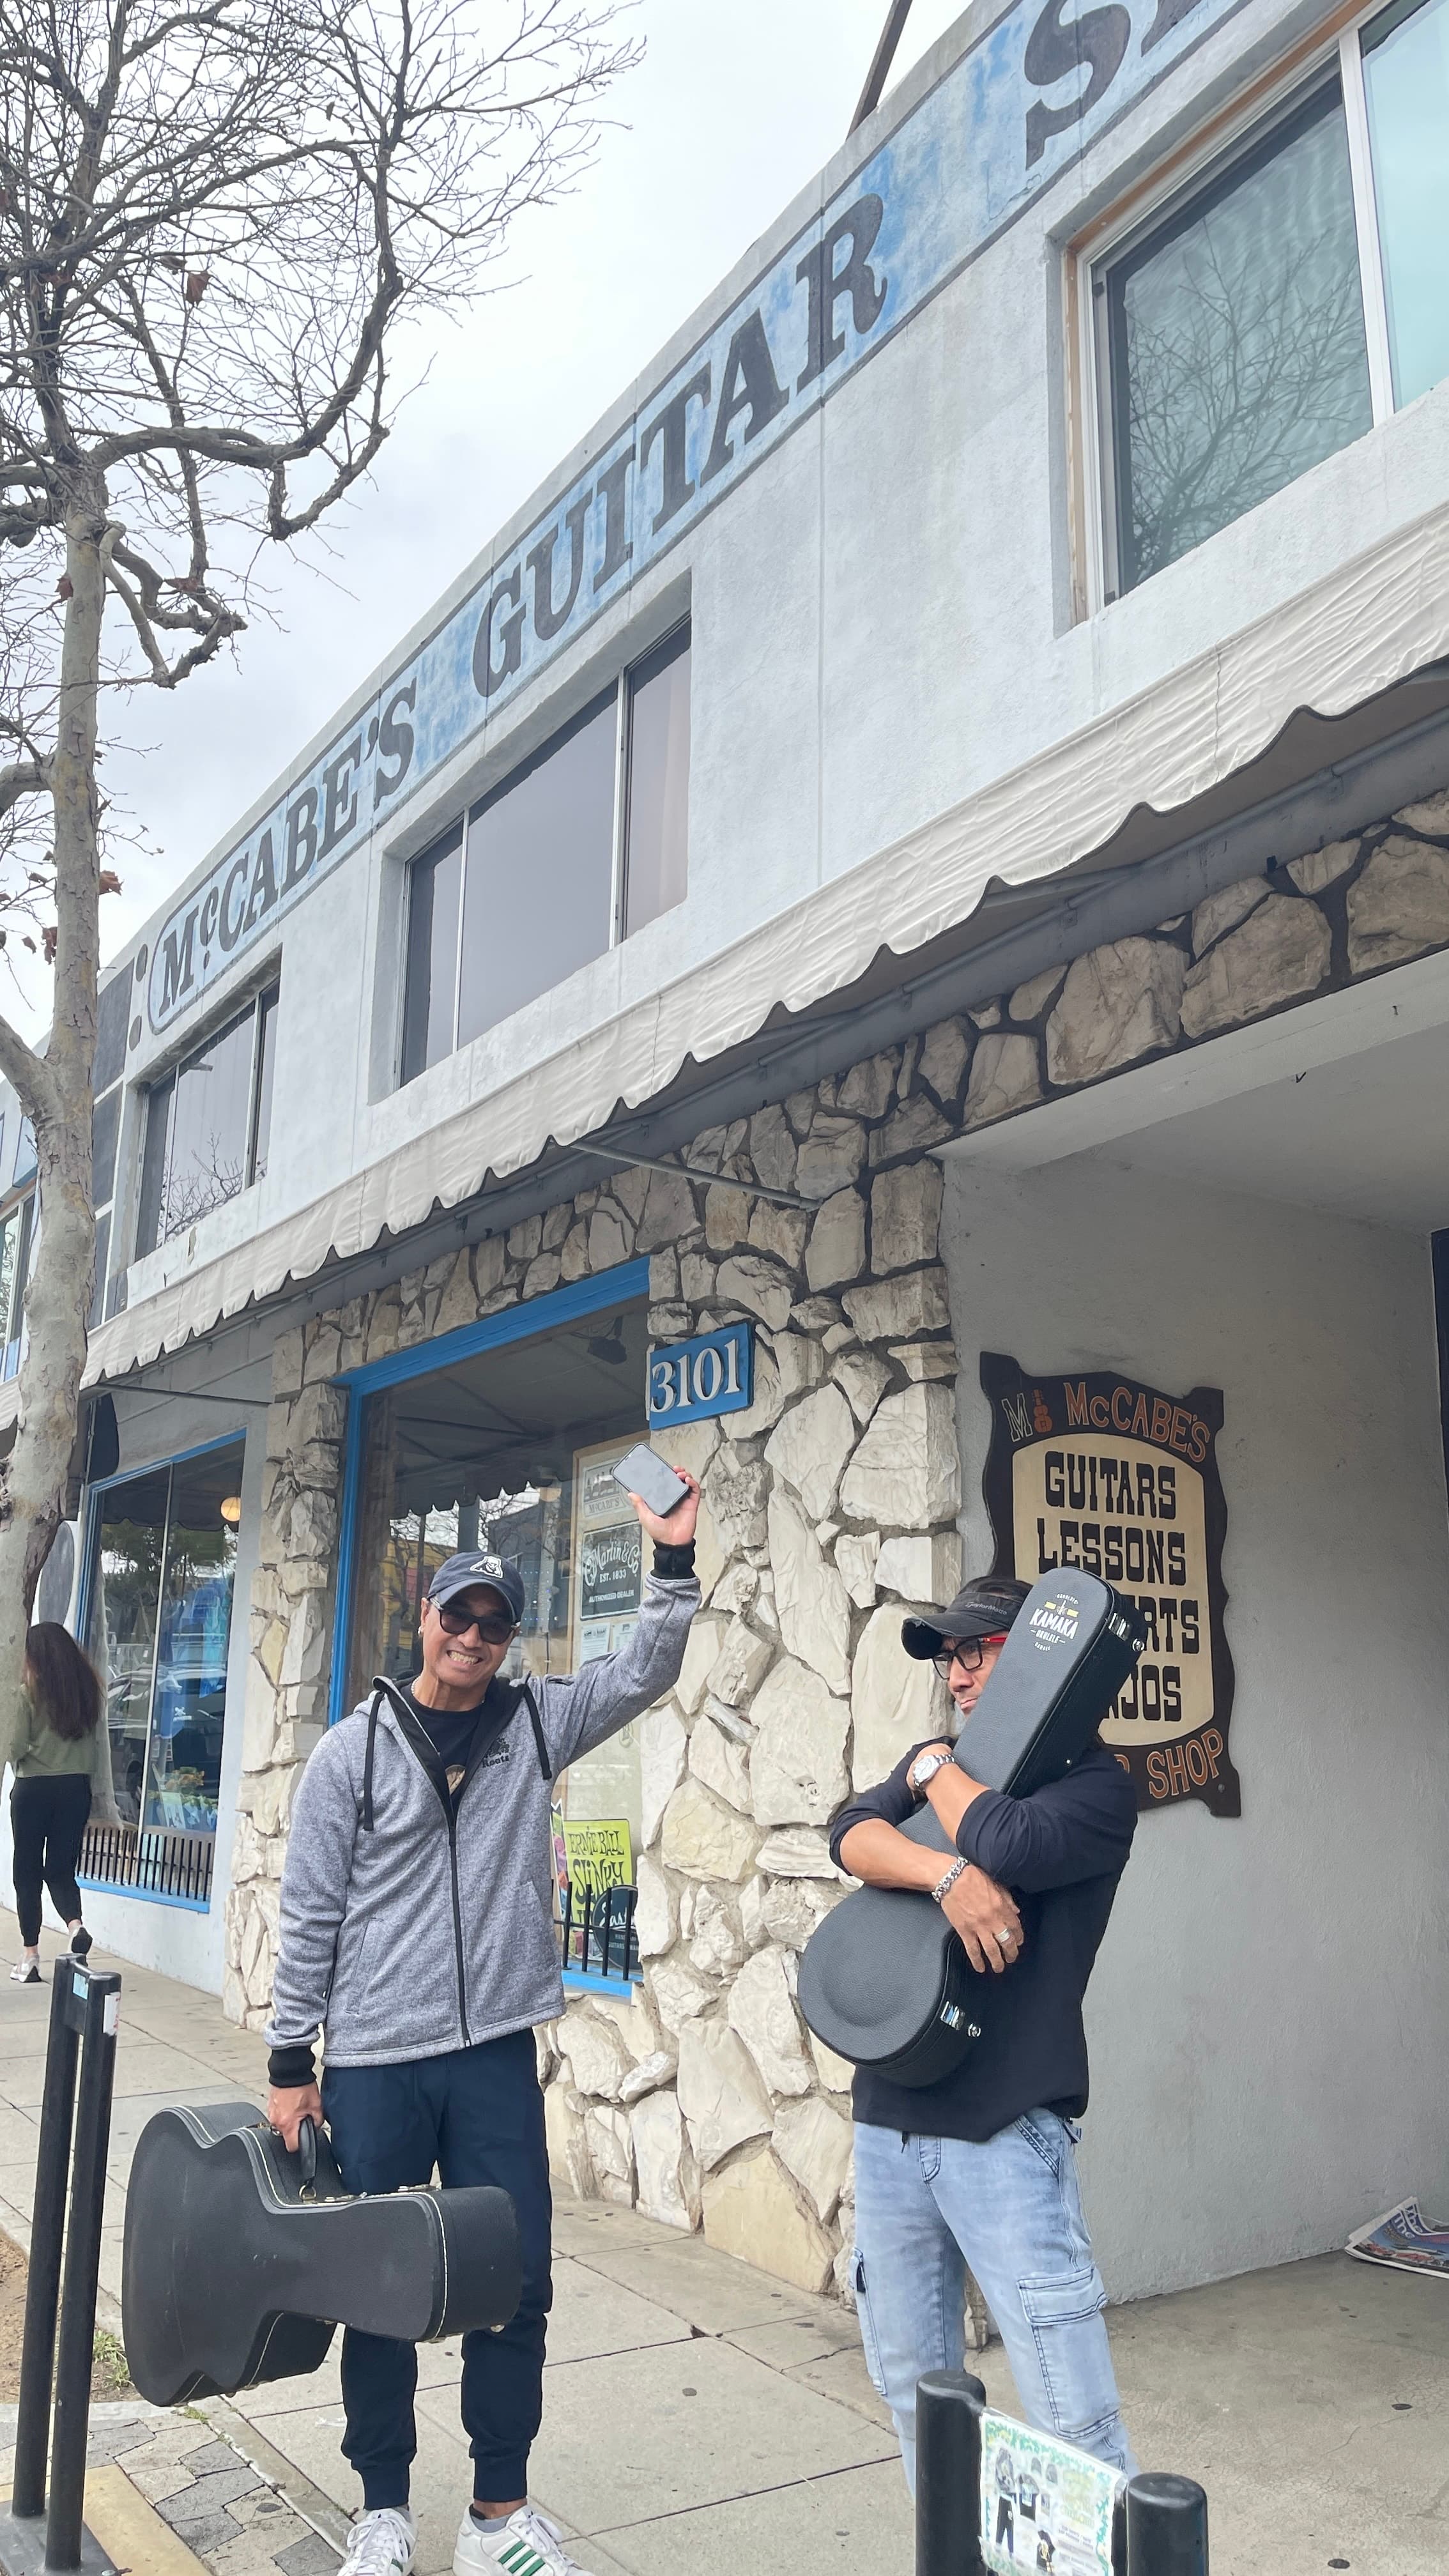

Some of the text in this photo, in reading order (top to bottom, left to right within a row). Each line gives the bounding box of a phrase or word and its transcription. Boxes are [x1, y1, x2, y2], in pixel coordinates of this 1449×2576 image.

[159, 676, 417, 1018] McCABE'S
[473, 193, 888, 698] GUITAR
[650, 1338, 740, 1413] 3101
[1063, 1382, 1211, 1462] McCABE'S
[1045, 1450, 1176, 1521] GUITARS
[599, 1568, 627, 1583] EST. 1833
[1037, 1517, 1186, 1586] LESSONS
[617, 1588, 634, 1599] DEALER
[1029, 1608, 1079, 1640] KAMAKA
[1147, 1728, 1223, 1799] SHOP
[597, 1830, 624, 1856] BALL
